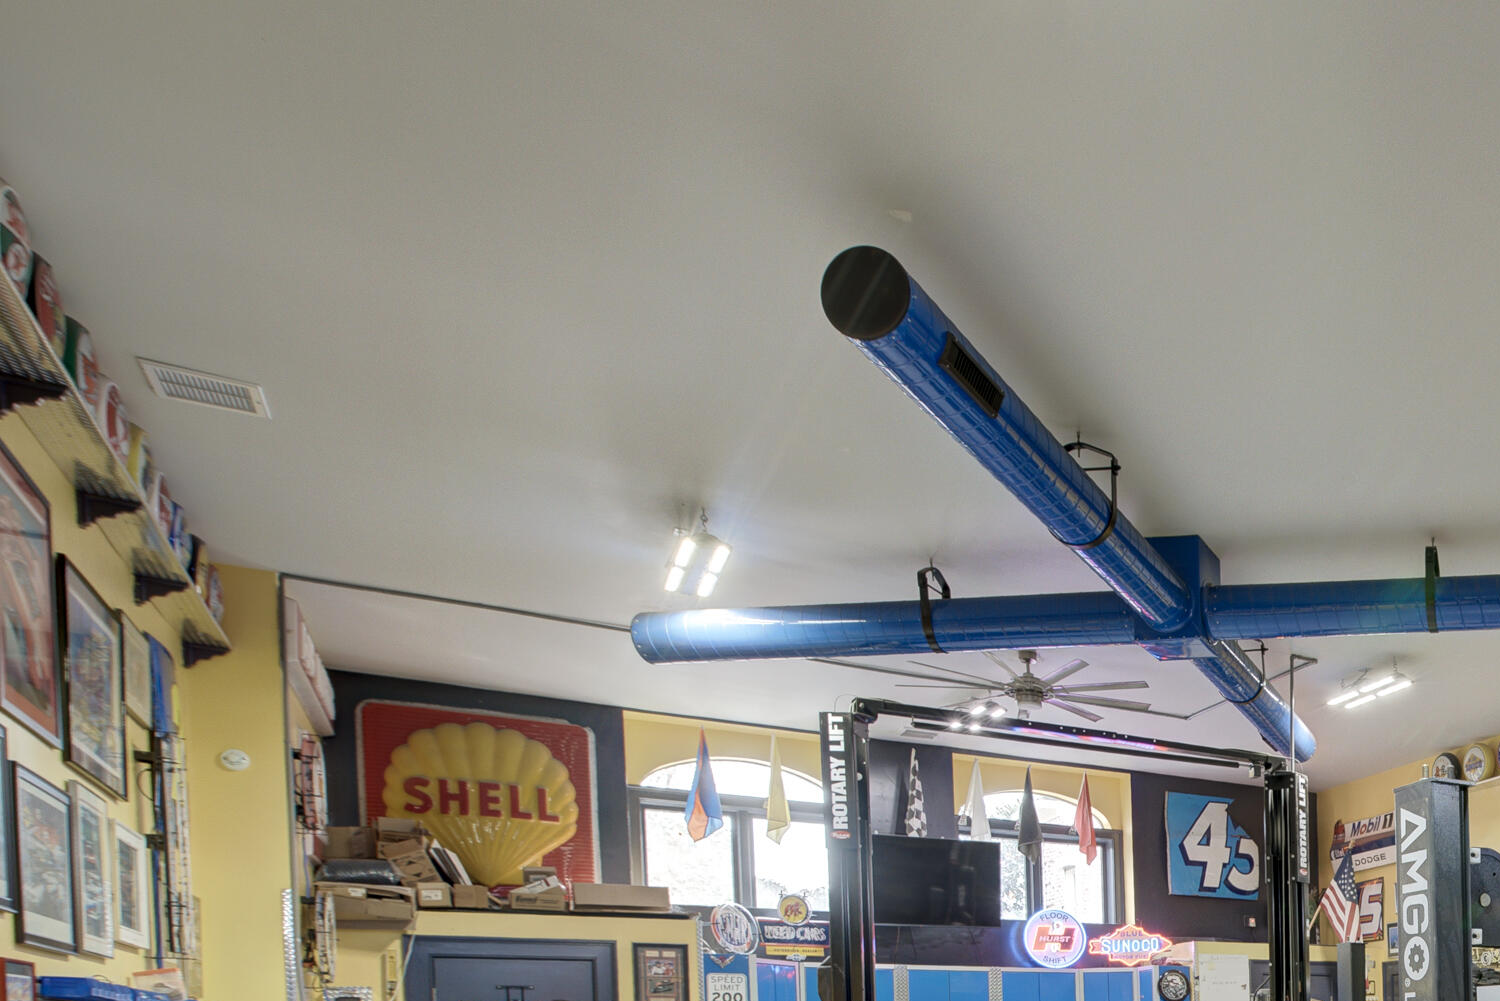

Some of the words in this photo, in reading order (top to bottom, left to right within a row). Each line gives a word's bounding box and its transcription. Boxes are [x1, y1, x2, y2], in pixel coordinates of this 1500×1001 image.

[827, 713, 846, 752] LIFT
[403, 776, 560, 822] SHELL
[829, 755, 849, 830] ROTARY
[1298, 775, 1307, 807] LIFT
[1299, 808, 1308, 868] ROTARY
[1351, 816, 1381, 838] Mobil
[1382, 812, 1394, 830] 1
[1355, 852, 1387, 867] DODGE
[1400, 808, 1430, 981] AMGO
[1039, 911, 1069, 923] FLOOR
[1039, 935, 1071, 943] HURST
[1101, 937, 1159, 953] SUNOCO
[1043, 955, 1067, 965] SHIFT
[711, 975, 744, 984] SPEED
